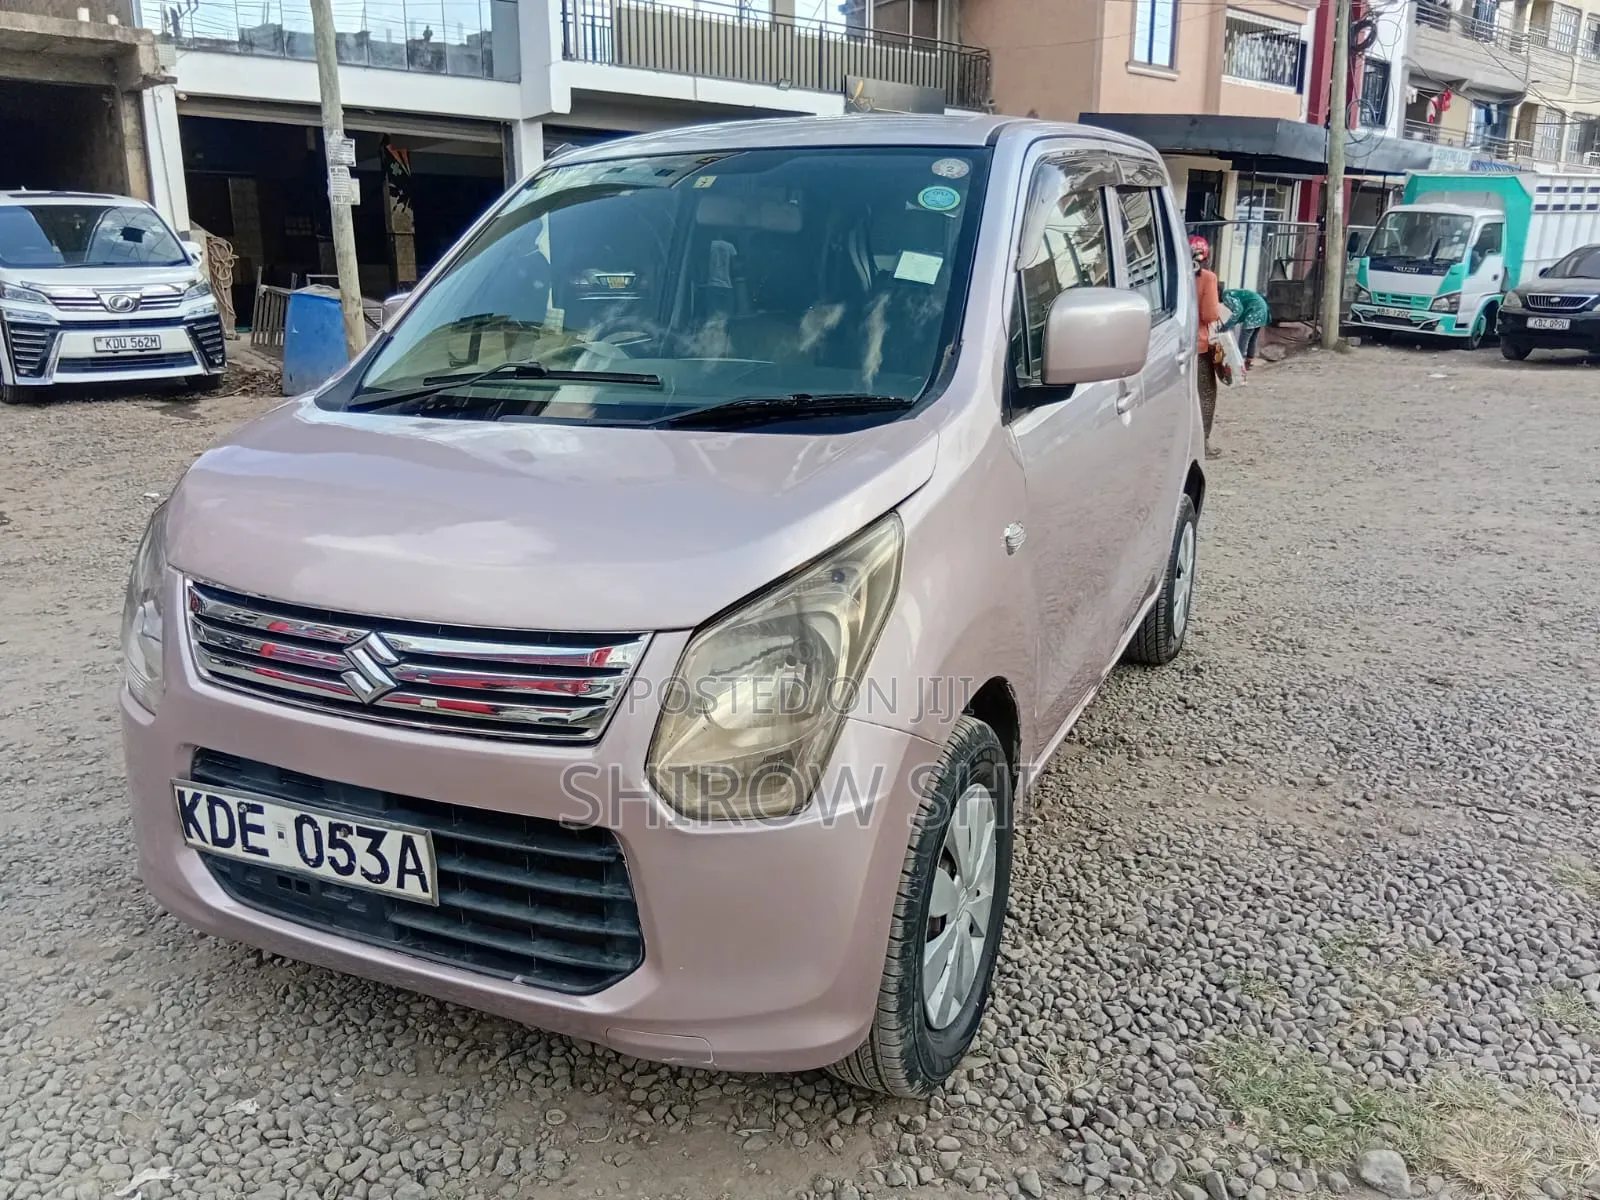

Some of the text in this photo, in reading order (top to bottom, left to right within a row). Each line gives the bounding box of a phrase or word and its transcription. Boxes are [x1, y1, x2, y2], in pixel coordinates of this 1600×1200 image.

[1534, 318, 1548, 328] KBZ
[105, 336, 158, 349] KDU 562M
[177, 789, 429, 894] KDE 053A
